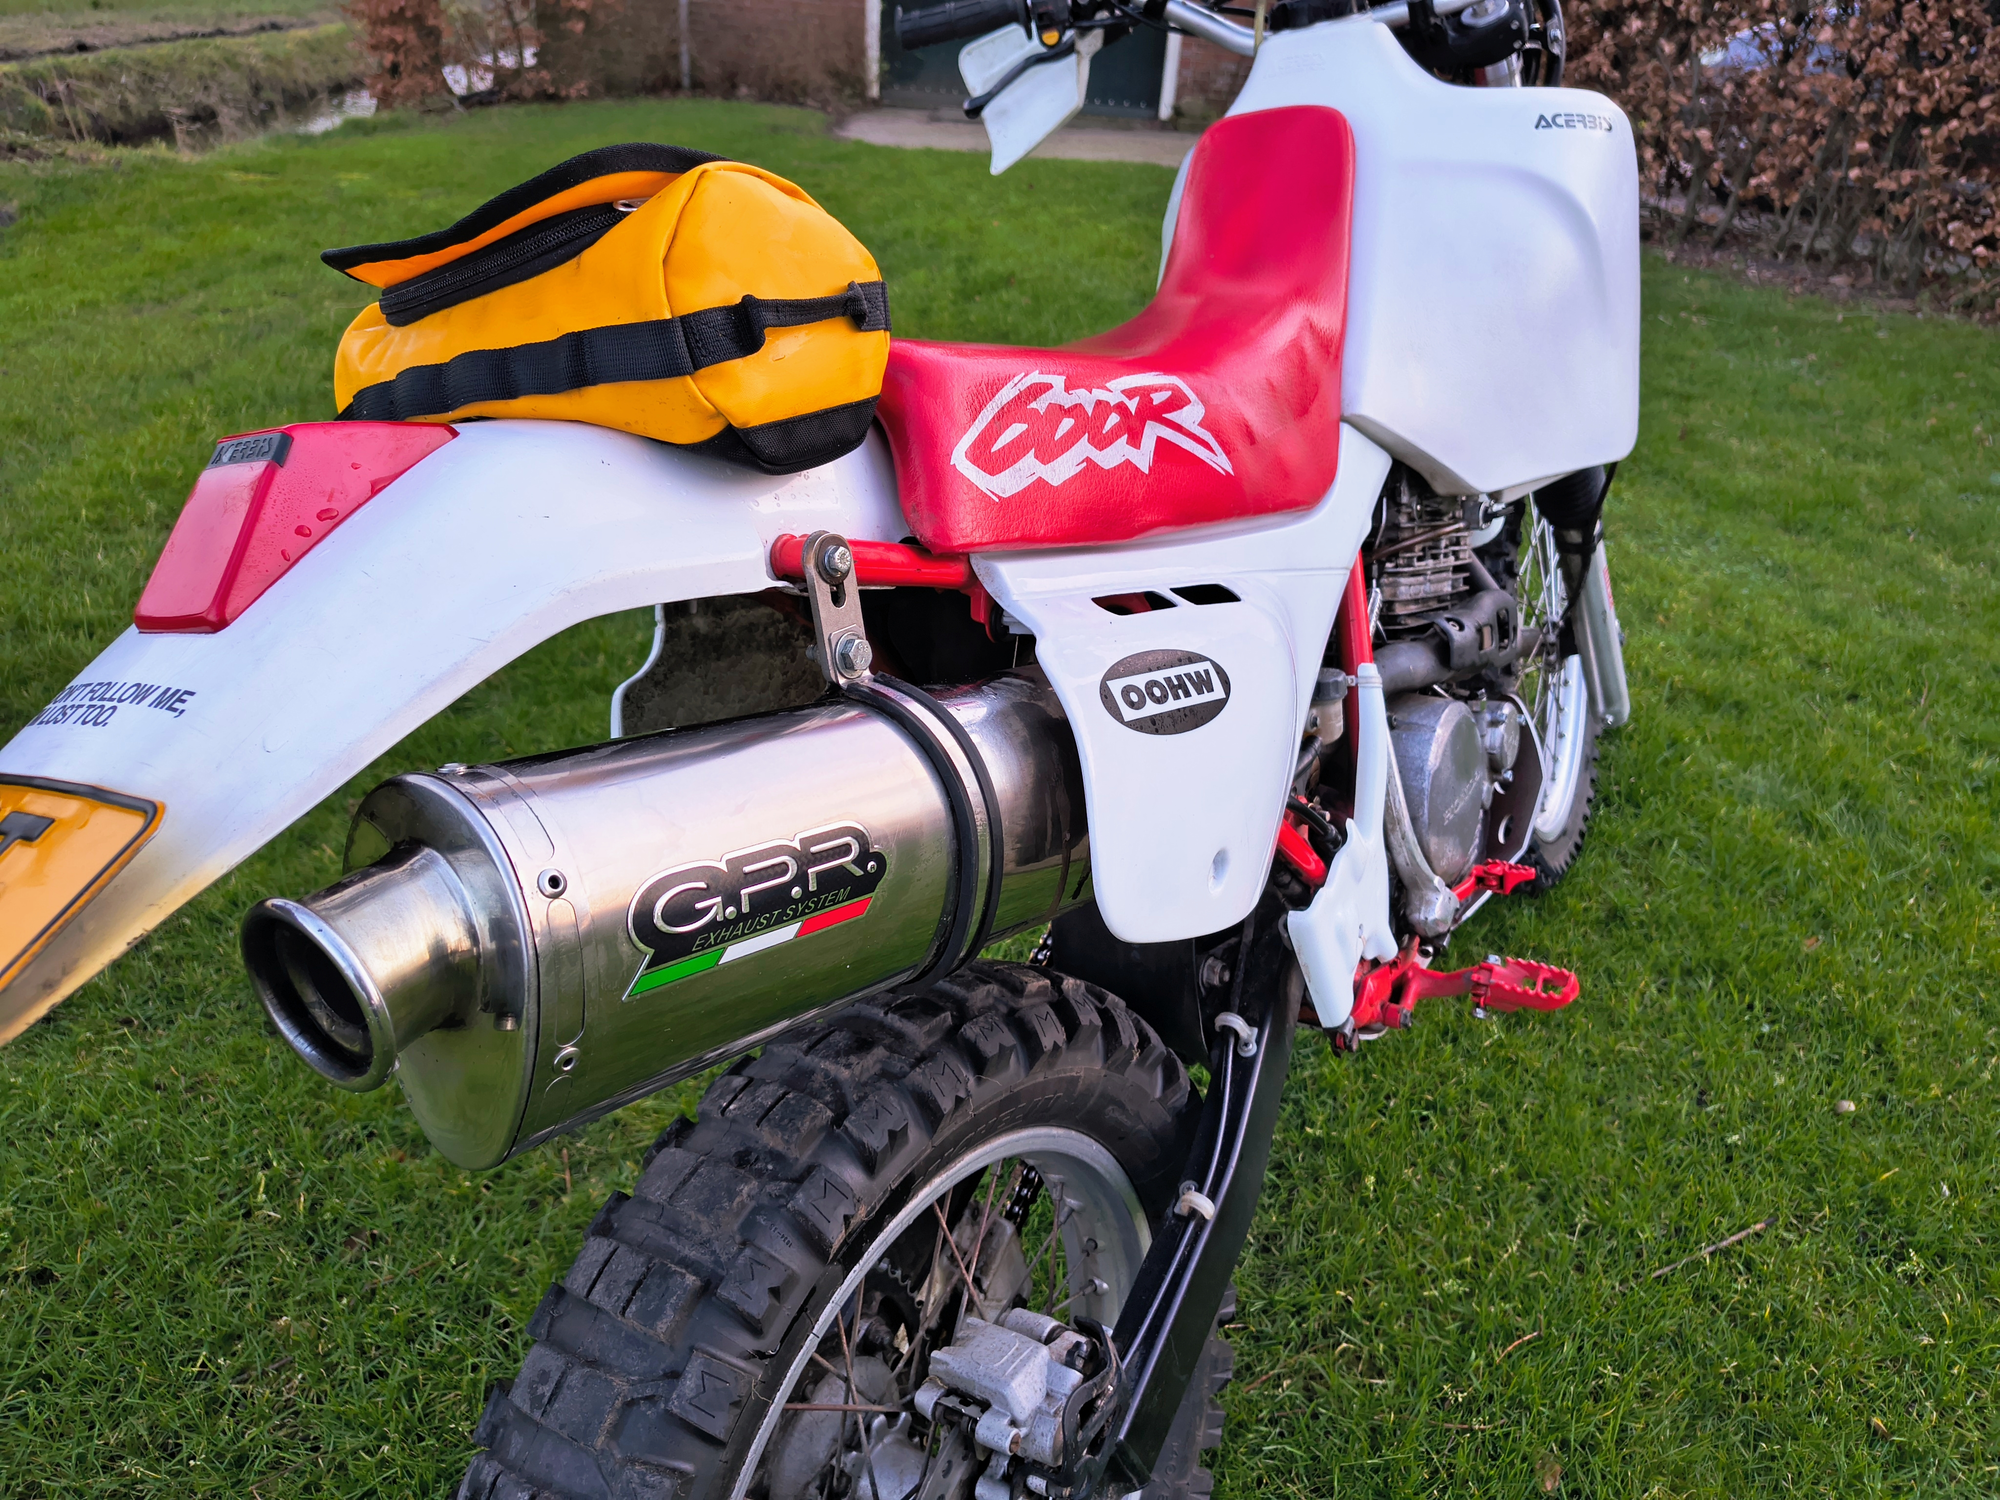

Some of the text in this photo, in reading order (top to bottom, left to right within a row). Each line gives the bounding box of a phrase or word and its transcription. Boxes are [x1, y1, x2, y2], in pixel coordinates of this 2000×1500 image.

[36, 704, 86, 726] LOST
[72, 704, 118, 727] TOO.
[88, 681, 162, 706] FOLLOW
[147, 686, 197, 719] ME,
[692, 886, 851, 952] EXHAUST SYSTEM
